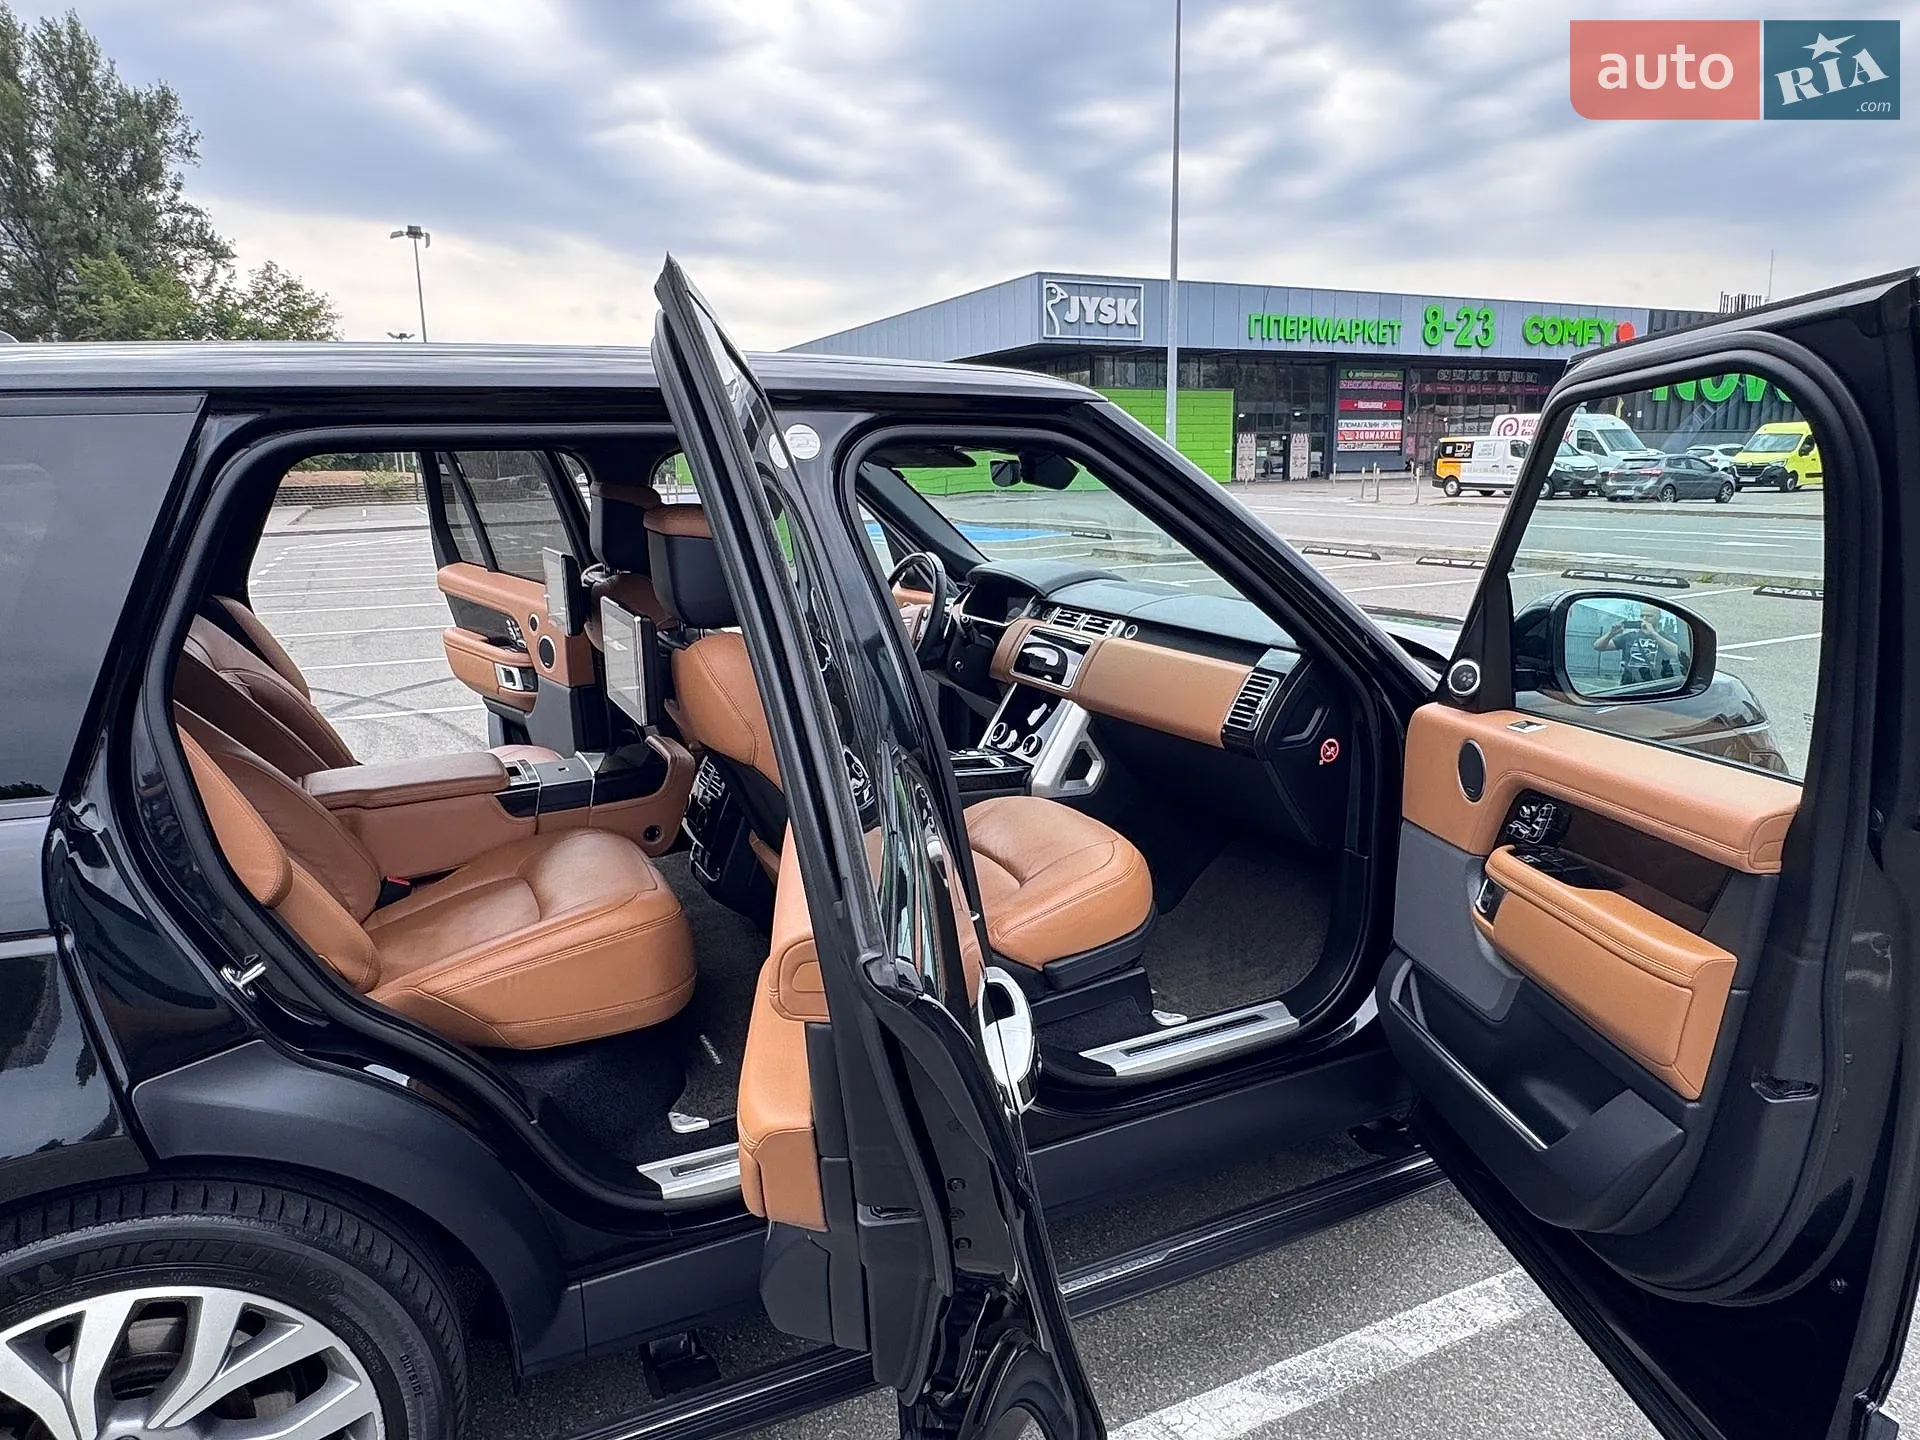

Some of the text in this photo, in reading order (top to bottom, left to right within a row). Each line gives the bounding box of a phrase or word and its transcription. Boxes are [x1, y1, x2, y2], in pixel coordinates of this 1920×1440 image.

[1064, 295, 1139, 326] JYSK
[1422, 303, 1496, 348] 8-23
[1248, 313, 1402, 344] ГІПЕРМАРКЕТ
[1523, 315, 1617, 347] COMFY
[73, 1238, 300, 1277] MICHELIN
[399, 1353, 425, 1398] OUTSIDE
